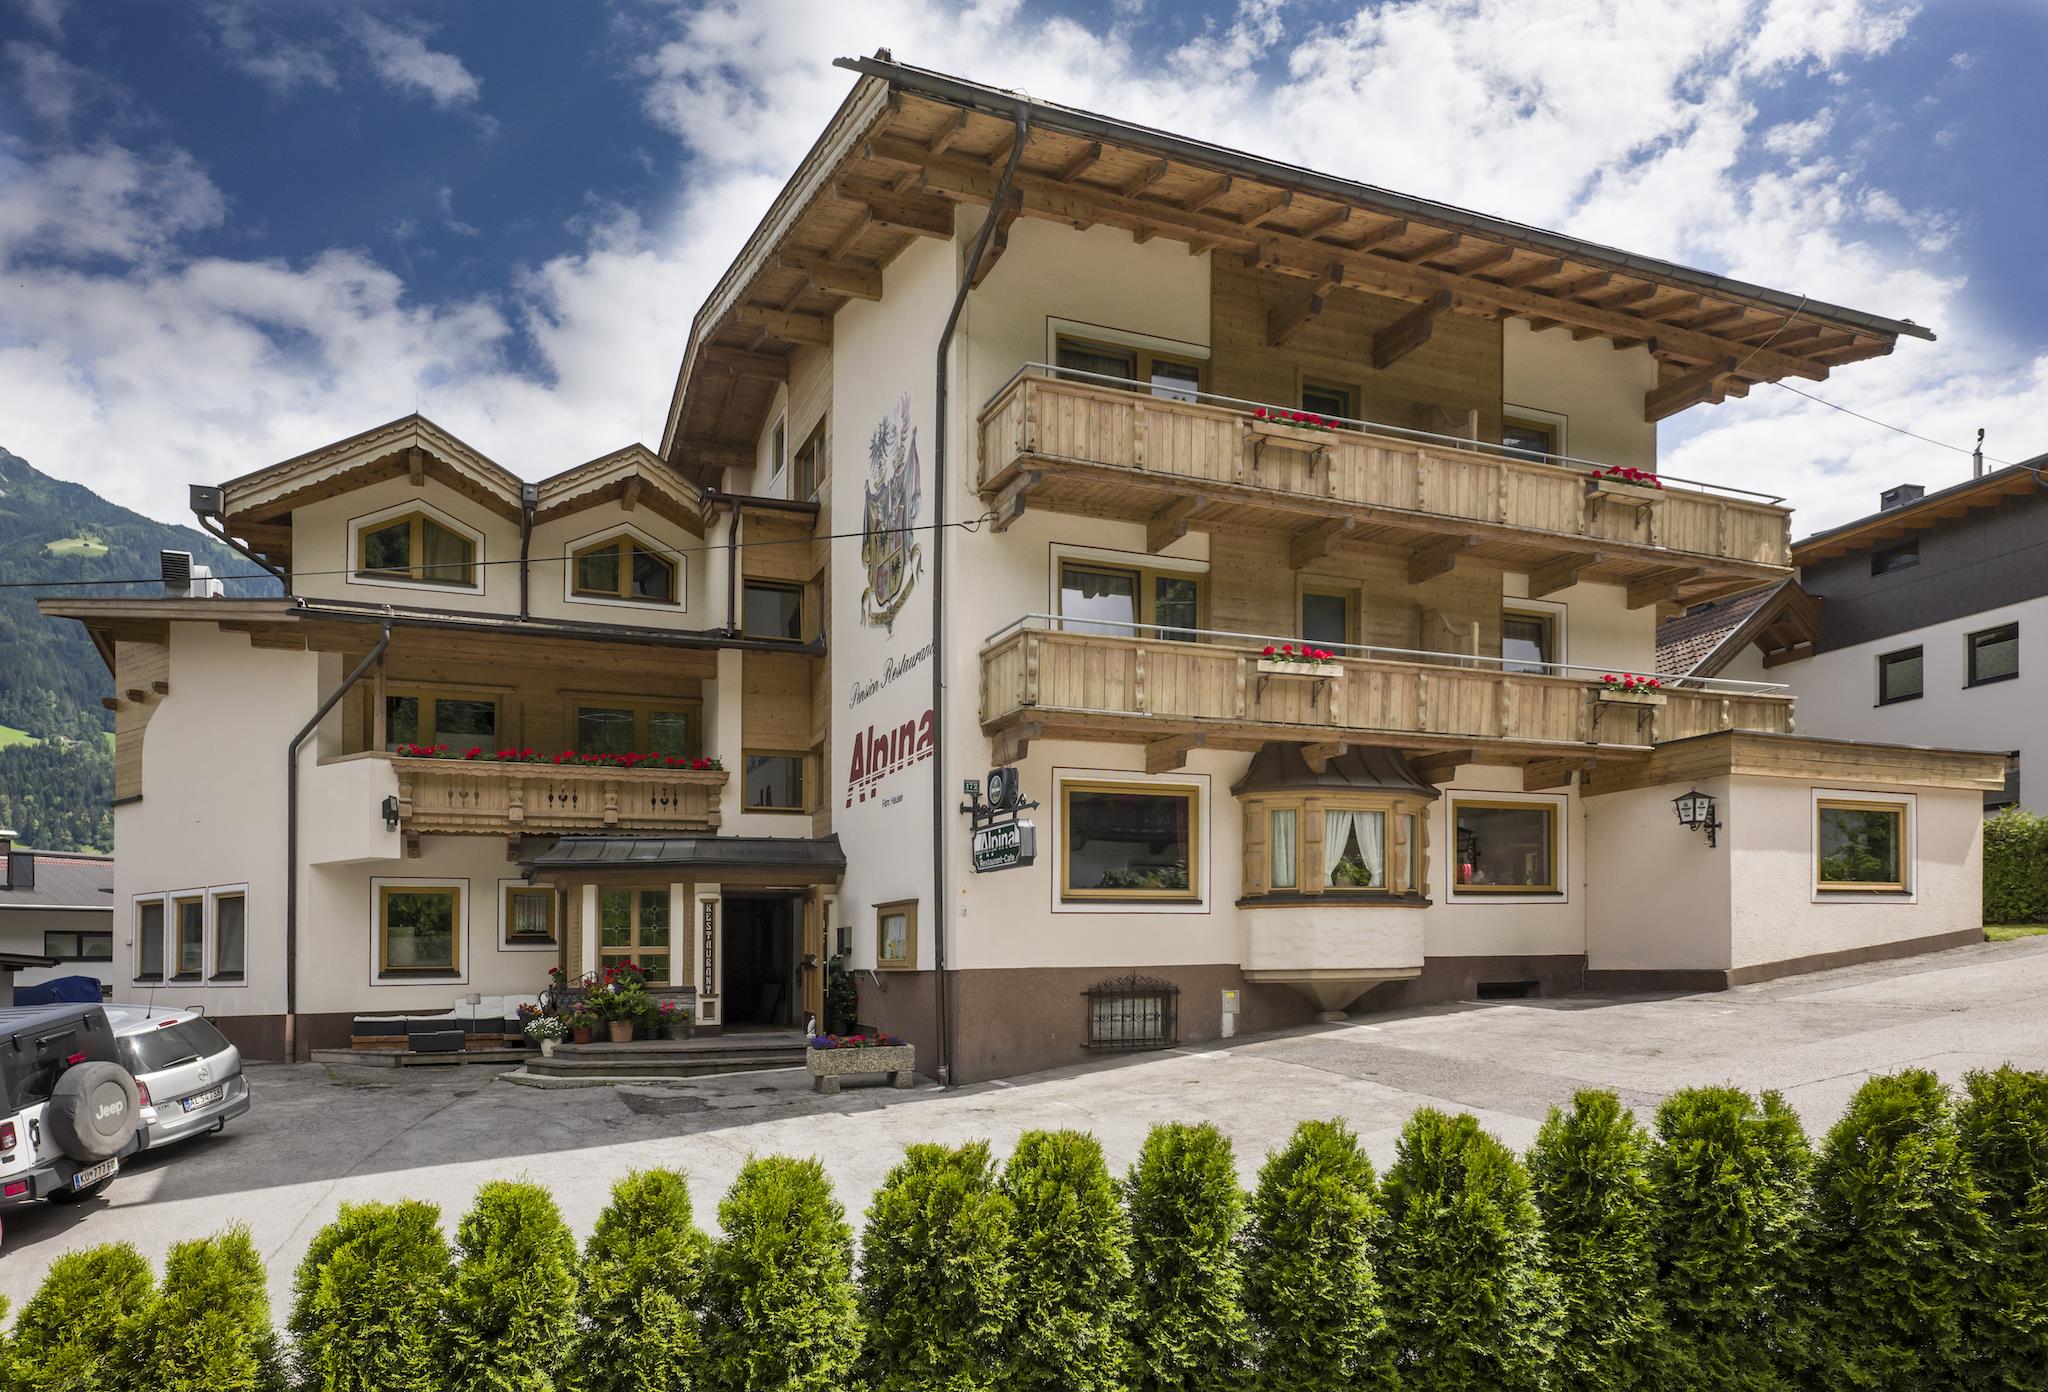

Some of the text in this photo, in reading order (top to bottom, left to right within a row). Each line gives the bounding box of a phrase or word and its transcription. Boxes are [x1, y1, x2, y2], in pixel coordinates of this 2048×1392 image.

[846, 709, 934, 808] Alpina
[980, 828, 1015, 851] Alpina
[95, 1100, 124, 1120] Jeep
